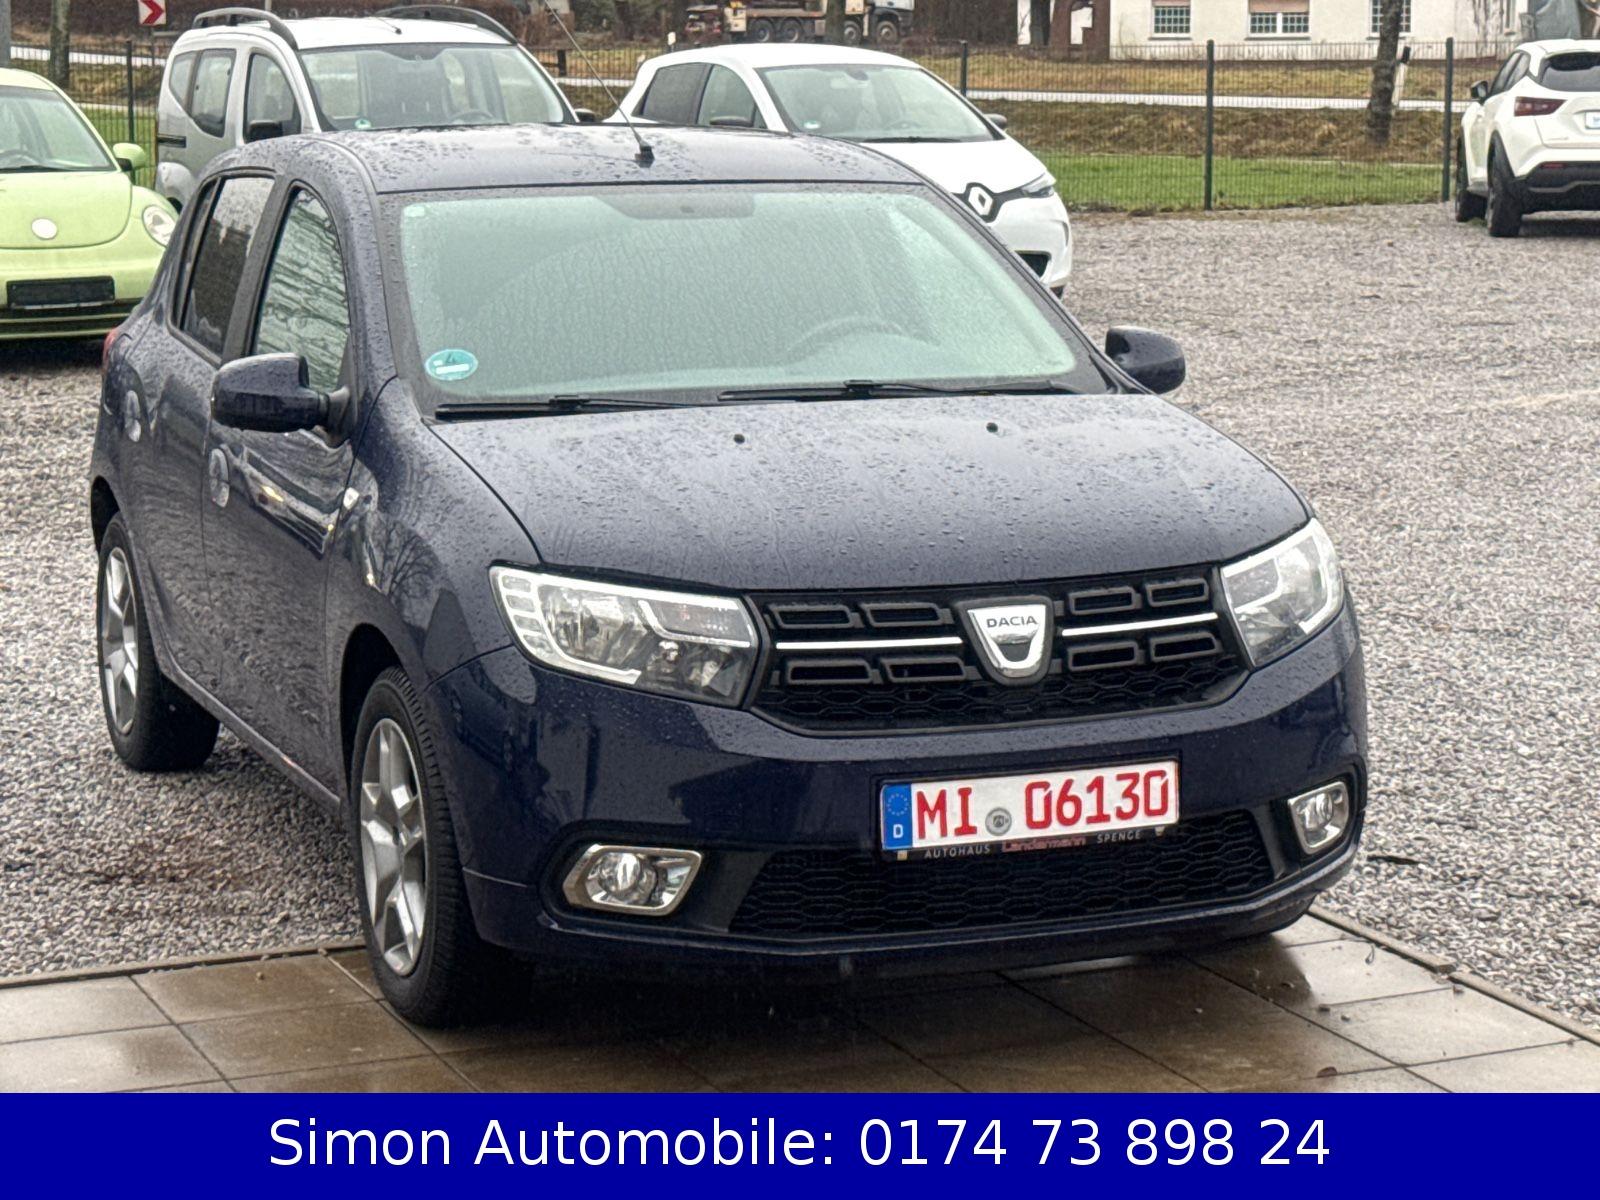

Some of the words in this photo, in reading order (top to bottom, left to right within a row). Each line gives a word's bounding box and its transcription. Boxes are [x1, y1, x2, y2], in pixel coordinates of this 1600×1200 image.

[986, 615, 1039, 629] DACIA
[915, 786, 978, 840] MI
[1024, 769, 1169, 831] 06130
[892, 823, 904, 839] D
[924, 843, 991, 860] AUTOHAUS
[1096, 829, 1142, 845] SPENGE
